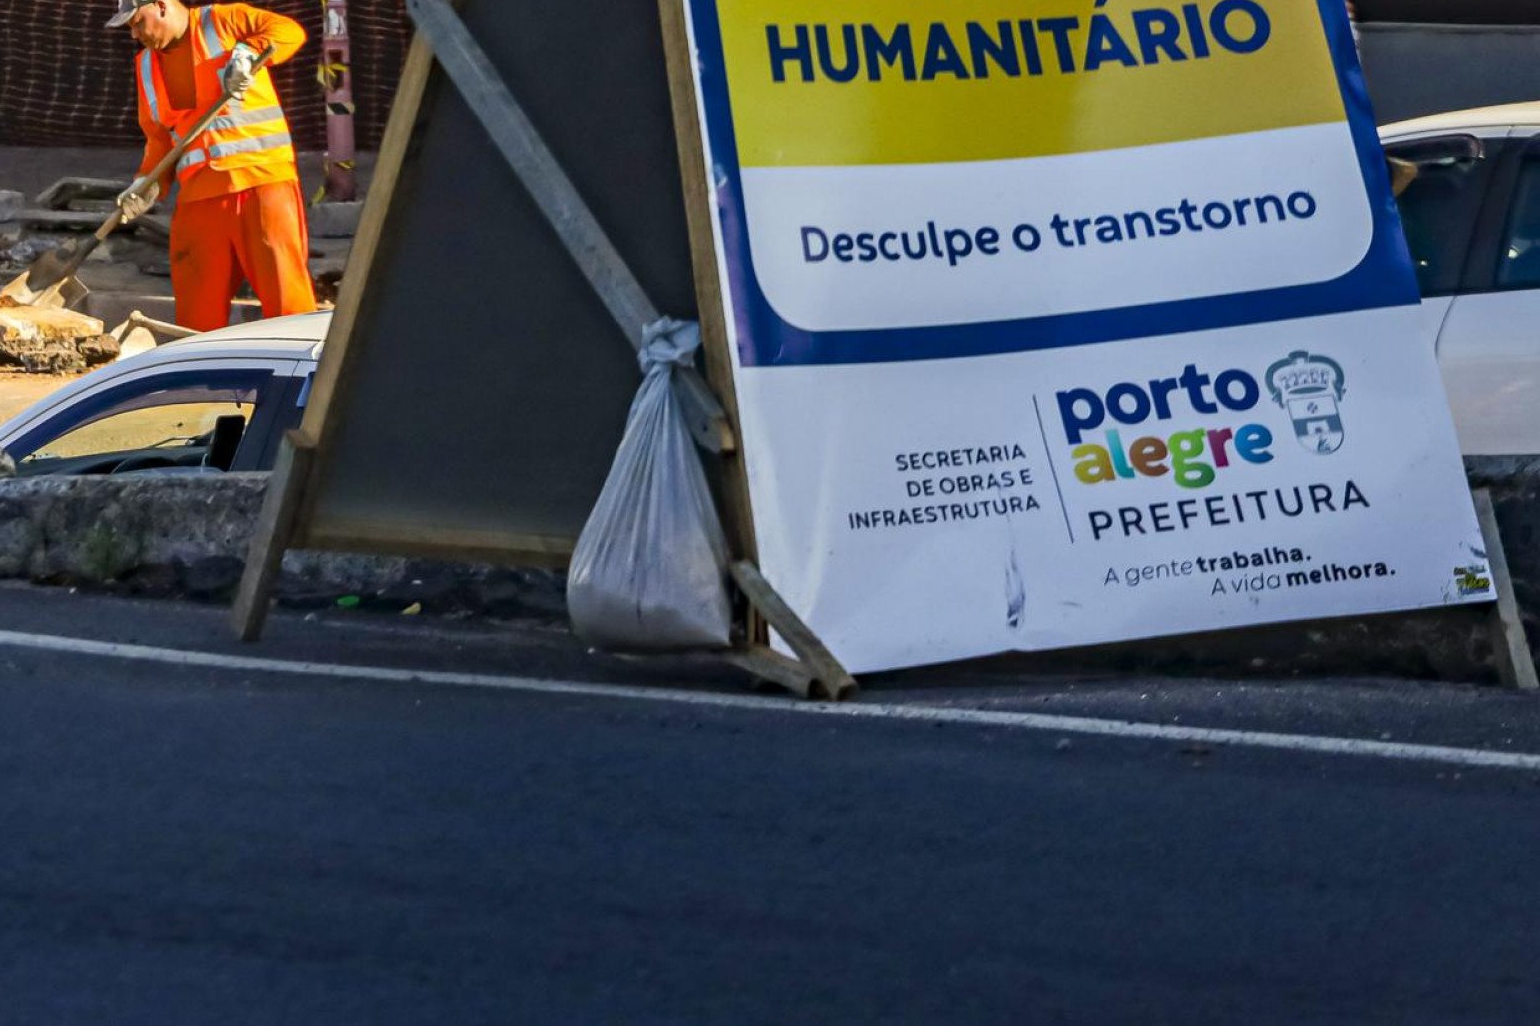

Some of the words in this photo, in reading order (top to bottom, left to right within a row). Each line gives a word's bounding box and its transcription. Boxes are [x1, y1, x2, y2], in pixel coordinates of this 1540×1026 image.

[800, 221, 1001, 267] Desculpe
[1012, 222, 1042, 252] o
[1050, 190, 1317, 247] transtorno
[1056, 364, 1260, 445] porto
[895, 443, 1026, 472] SECRETARIA
[1071, 423, 1274, 489] alegre
[906, 479, 935, 498] DE
[939, 471, 1015, 495] OBRAS
[1020, 468, 1034, 485] E
[848, 494, 1041, 530] INFRAESTRUTURA
[1088, 480, 1371, 541] PREFEITURA
[1103, 567, 1120, 586] A
[1124, 557, 1193, 587] gente
[1196, 546, 1313, 574] trabalha.
[1211, 577, 1227, 596] A
[1230, 571, 1281, 594] vida
[1285, 560, 1397, 587] melhora.
